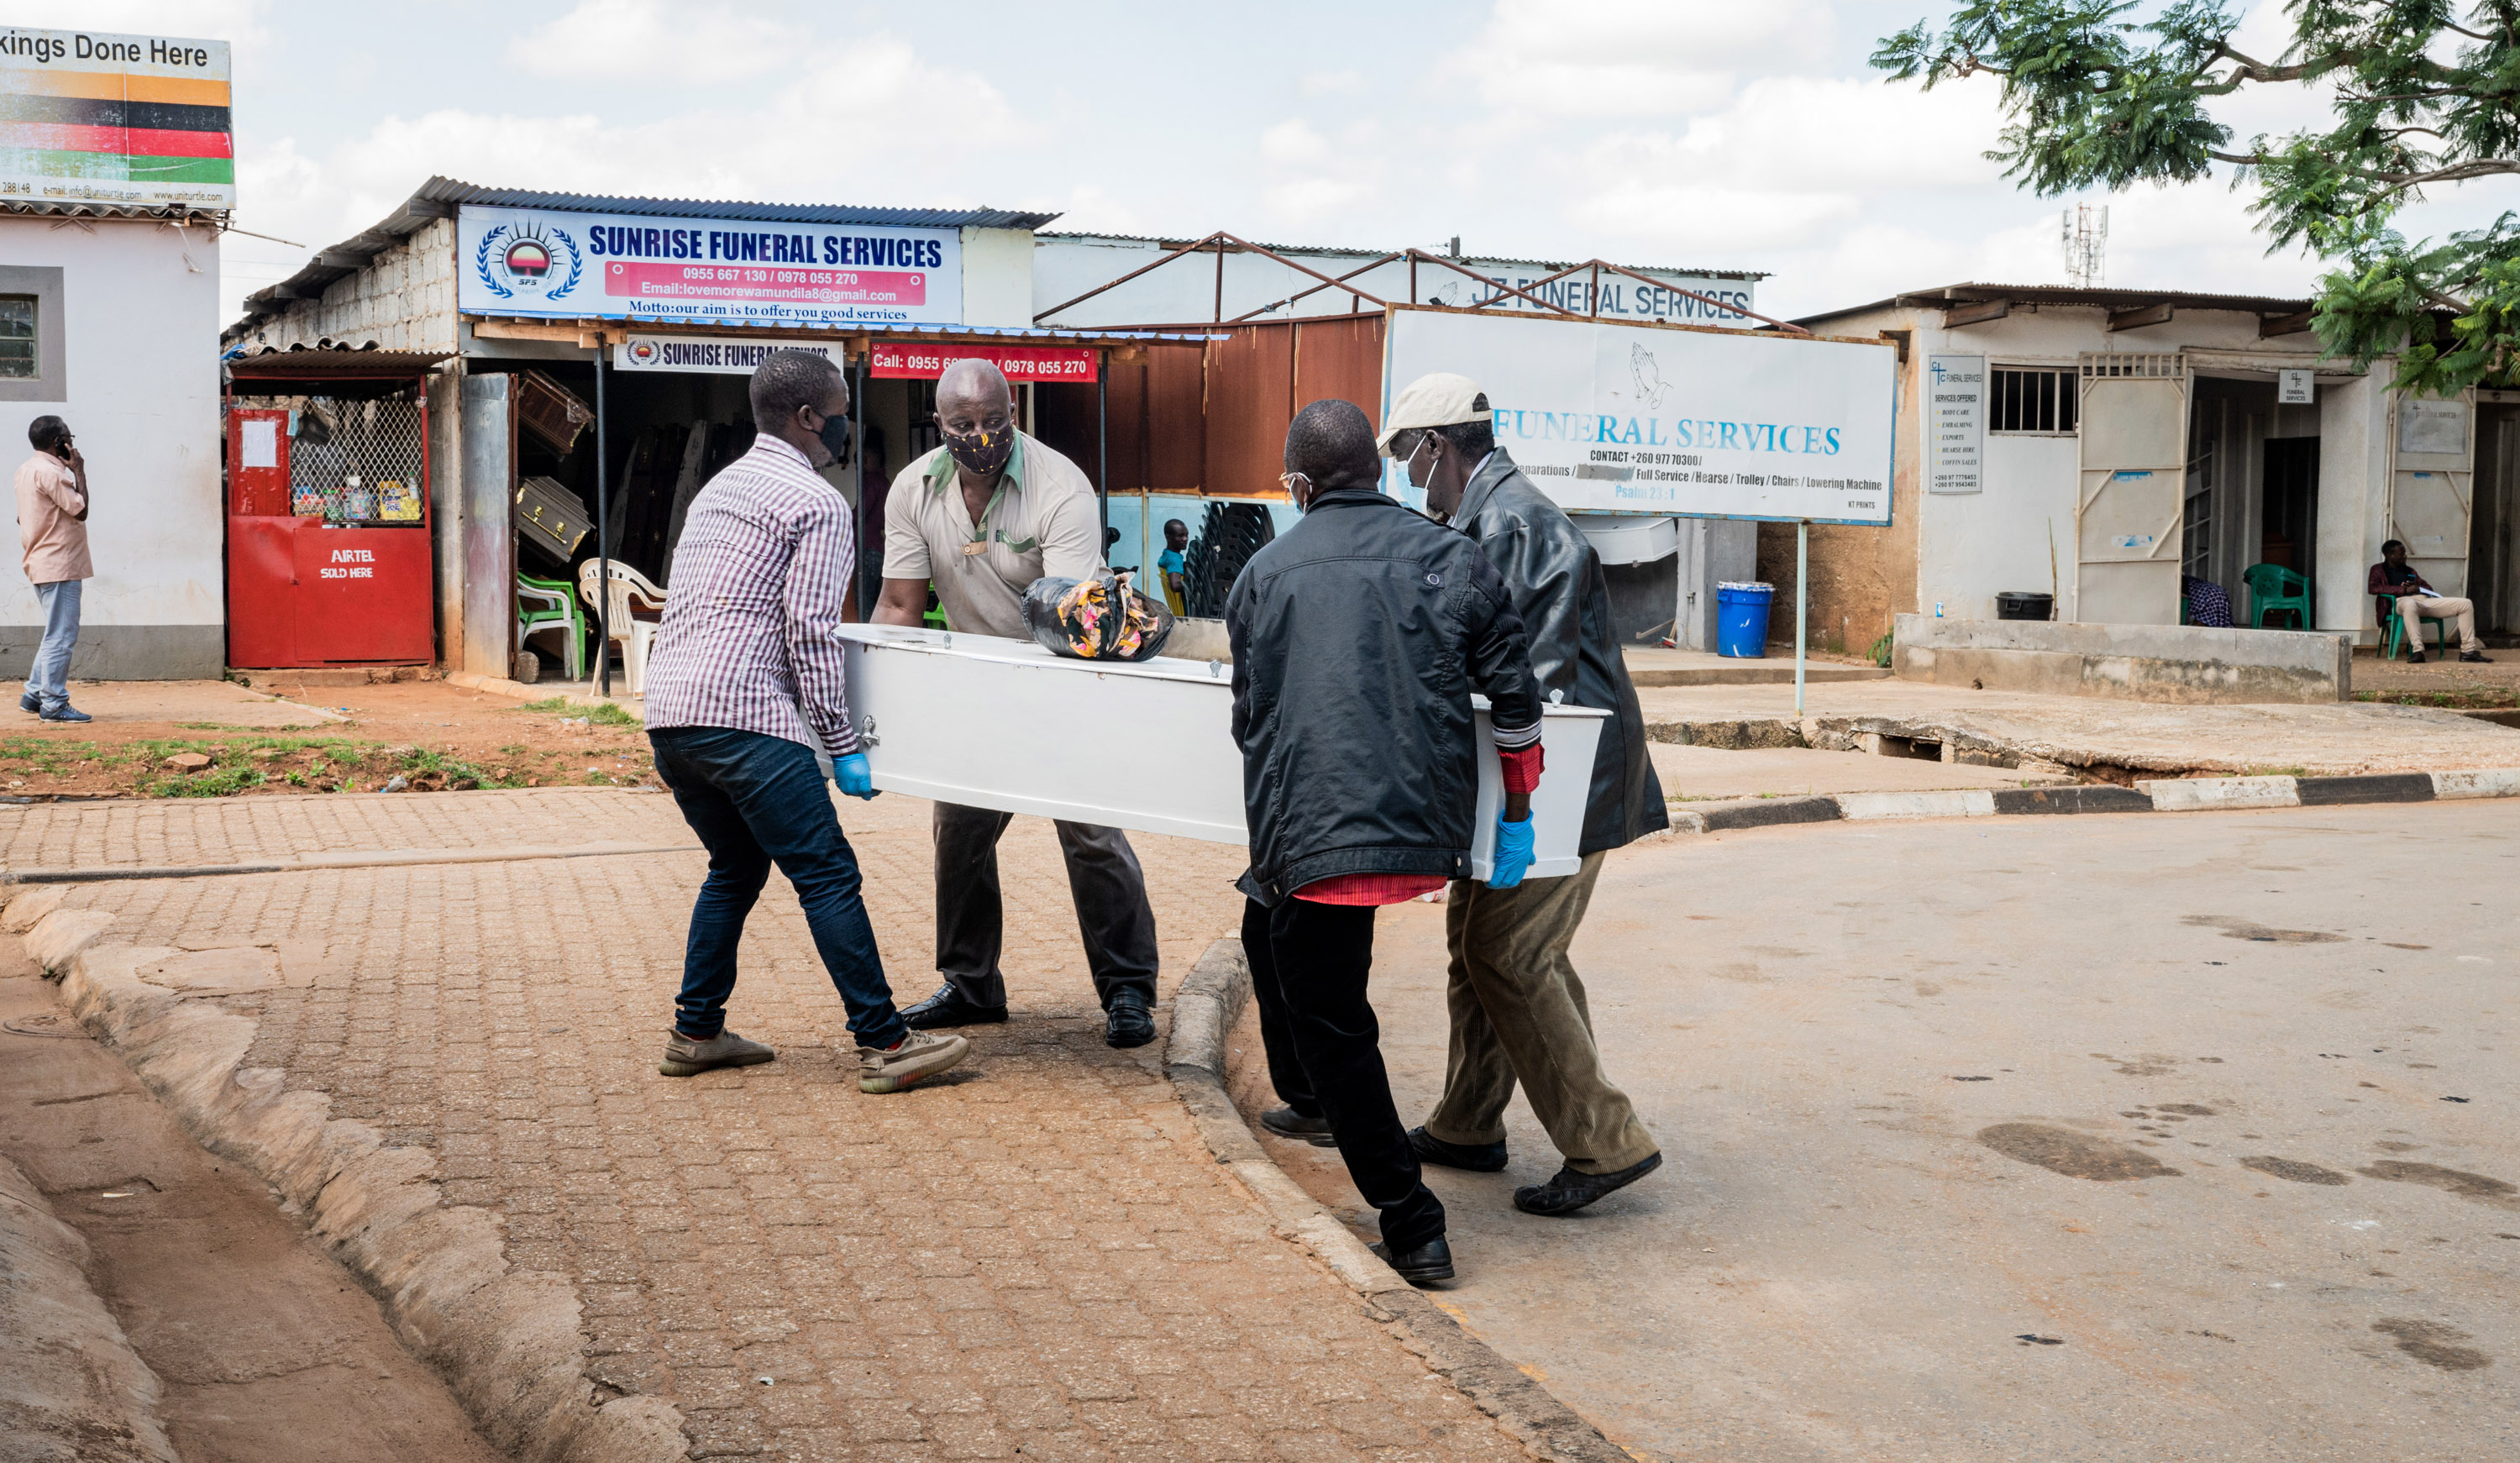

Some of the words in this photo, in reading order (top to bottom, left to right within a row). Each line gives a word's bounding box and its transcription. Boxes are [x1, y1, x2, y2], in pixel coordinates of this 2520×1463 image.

[76, 34, 141, 62] Done
[150, 39, 208, 67] Here
[3, 181, 31, 193] 288148
[43, 186, 67, 197] e-mail:
[69, 186, 142, 200] info@uniturtle.com
[154, 191, 223, 202] www.uniturtle.com
[590, 225, 702, 259] SUNRISE
[710, 231, 817, 264] FUNERAL
[824, 235, 942, 268] SERVICES
[683, 267, 714, 280] 0955
[717, 269, 740, 281] 667
[744, 270, 766, 282] 130
[769, 270, 774, 281] /
[777, 270, 806, 283] 0978
[810, 272, 832, 284] 055
[835, 273, 858, 285] 270
[642, 281, 896, 302] Email:lovemorewamundila8@gmail.com
[1517, 278, 1629, 313] FUNERAL
[1635, 286, 1749, 320] SERVICES
[702, 303, 727, 315] aim
[731, 304, 742, 315] is
[745, 305, 757, 316] to
[761, 305, 791, 317] offer
[795, 310, 818, 322] you
[821, 307, 853, 321] good
[857, 308, 907, 319] services
[663, 343, 722, 365] SUNRISE
[874, 354, 904, 368] Call:
[908, 356, 939, 370] 0955
[1005, 359, 1034, 373] 0978
[1038, 361, 1062, 374] 055
[1064, 361, 1086, 373] 270
[1932, 361, 1937, 370] C
[1493, 408, 1667, 446] FUNERAL
[1676, 419, 1840, 455] SERVICES
[1590, 450, 1629, 463] CONTACT
[1630, 453, 1653, 464] +260
[1656, 454, 1670, 464] 977
[1519, 464, 1570, 476] eparations
[1637, 469, 1652, 480] Full
[1655, 469, 1688, 482] Service
[1736, 474, 1764, 486] Trolley
[1772, 475, 1799, 487] Chairs
[1807, 477, 1845, 490] Lowering
[1846, 479, 1882, 491] Machine
[331, 549, 375, 563] AIRTEL
[320, 568, 347, 579] SOLD
[349, 567, 373, 578] HERE
